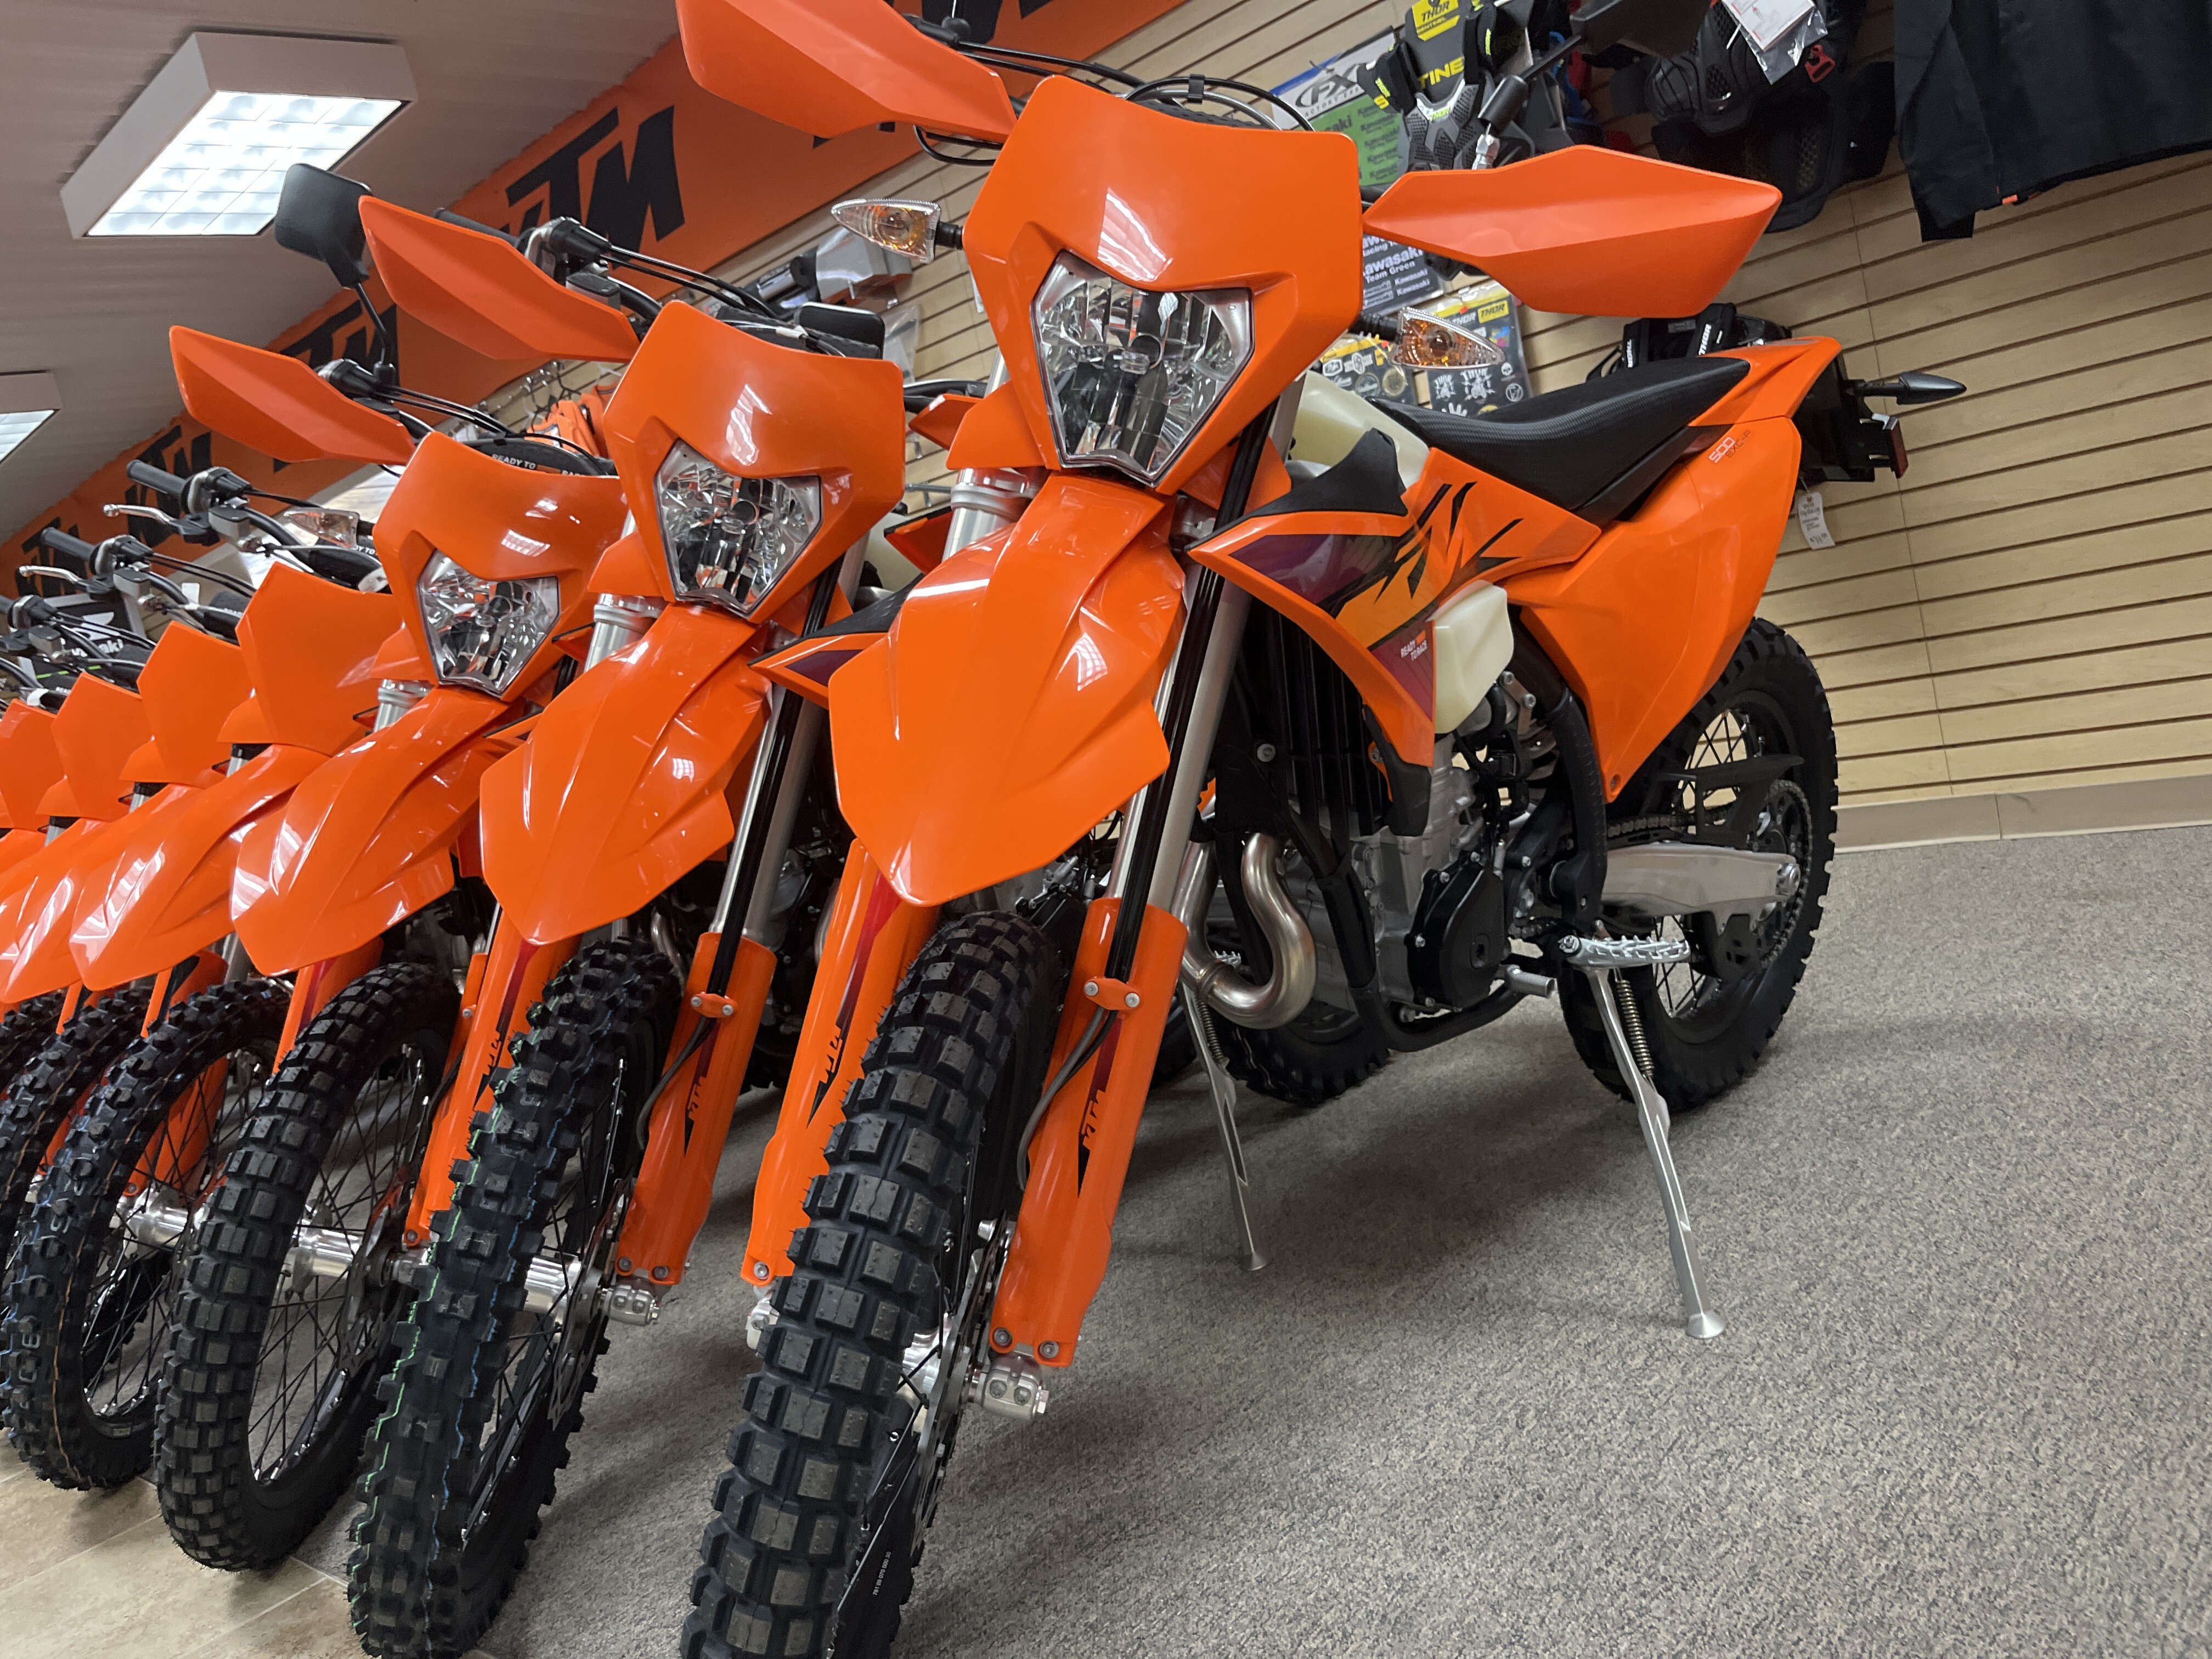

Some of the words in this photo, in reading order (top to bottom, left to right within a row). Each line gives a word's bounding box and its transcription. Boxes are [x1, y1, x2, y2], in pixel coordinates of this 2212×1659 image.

[1420, 2, 1451, 22] THOR
[504, 105, 686, 270] TM
[1363, 242, 1388, 257] acing
[1363, 246, 1424, 276] awasaki
[1365, 270, 1387, 284] Team
[1389, 261, 1415, 274] Green
[1453, 312, 1477, 326] THOR
[1482, 303, 1505, 316] THOR
[492, 454, 523, 466] READY
[524, 460, 537, 470] TO
[1709, 437, 1735, 464] 500
[365, 547, 376, 555] TO
